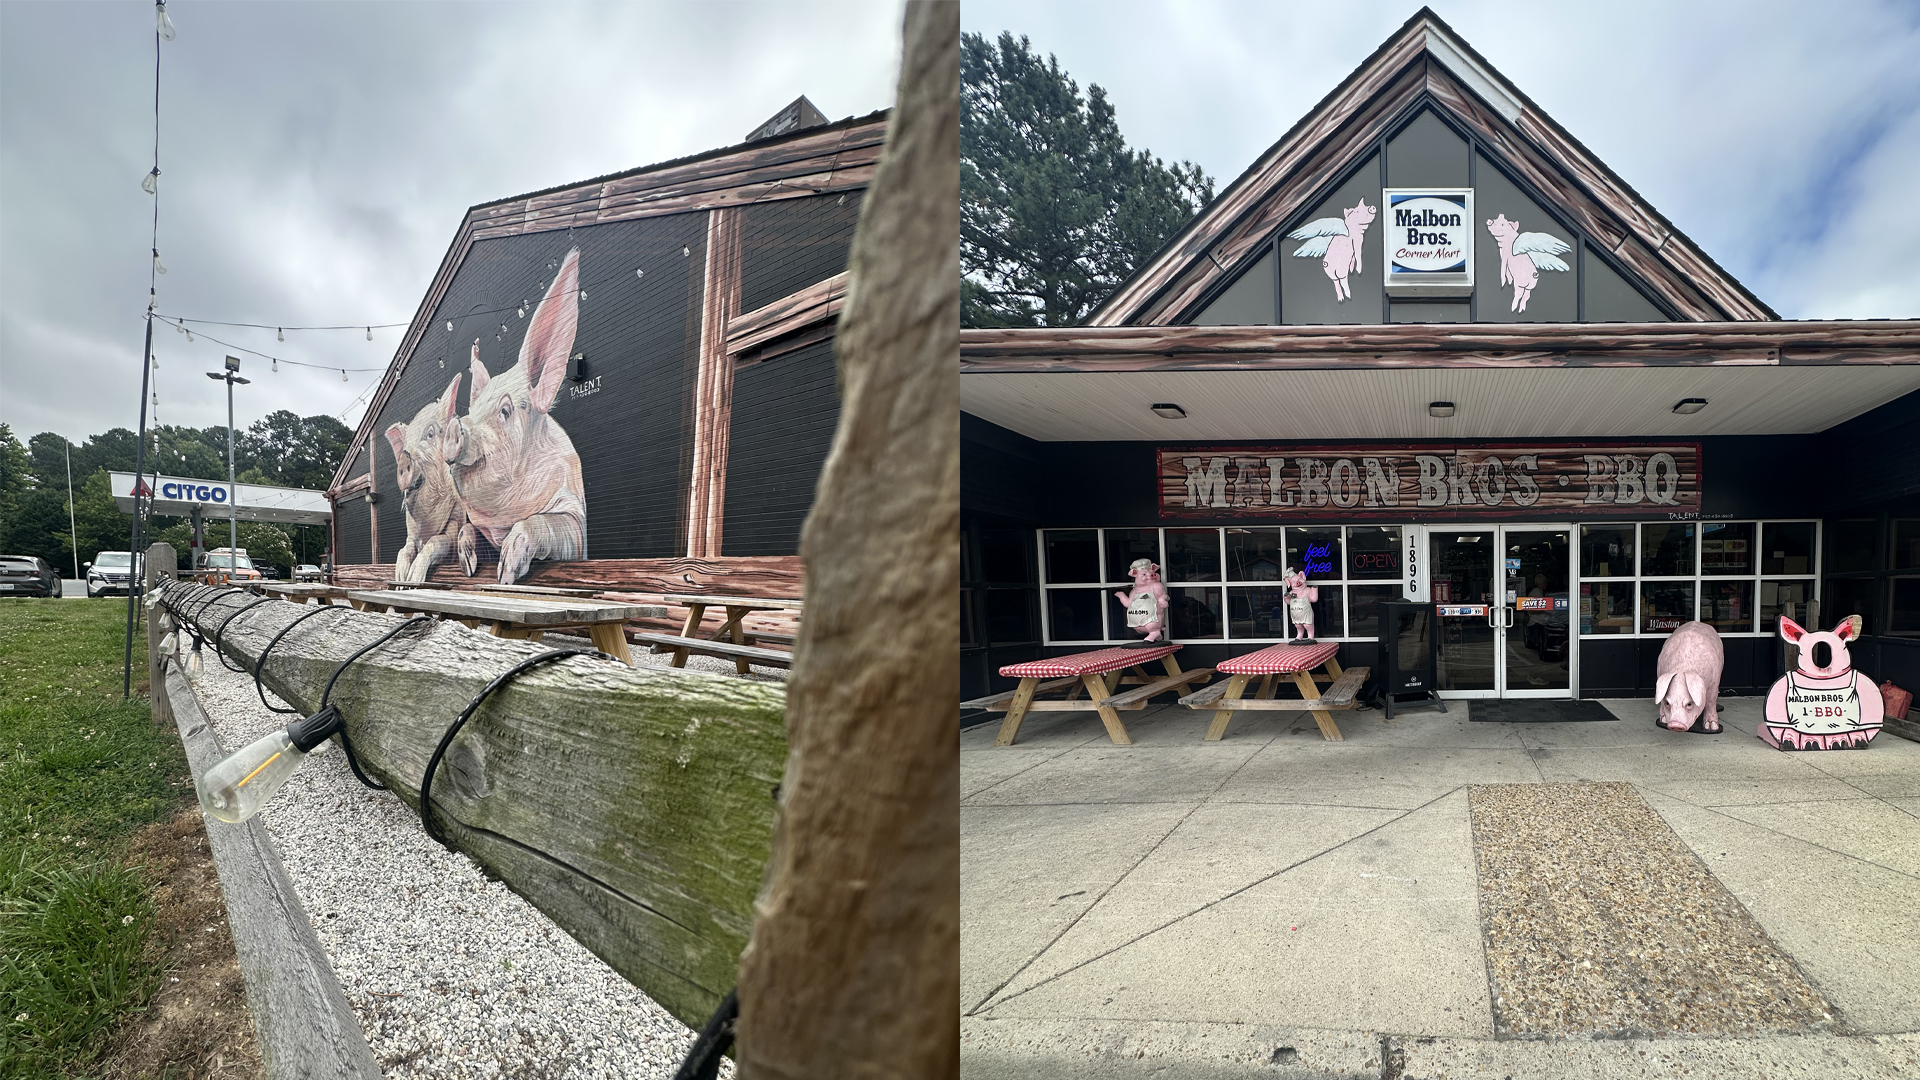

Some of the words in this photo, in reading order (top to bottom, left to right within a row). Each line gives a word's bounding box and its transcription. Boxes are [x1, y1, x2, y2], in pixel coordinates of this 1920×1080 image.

[1396, 209, 1461, 226] Malbon
[1407, 228, 1451, 245] Bros.
[1396, 248, 1432, 258] Corner
[1433, 248, 1460, 259] Mart
[1182, 456, 1400, 508] MALBON
[1415, 454, 1541, 506] BROS
[1583, 452, 1682, 506] BBQ
[162, 483, 227, 503] CITGO
[1304, 543, 1331, 562] feel
[1304, 559, 1332, 576] free
[1354, 554, 1397, 569] OPEN
[1409, 535, 1417, 592] 1896
[1649, 619, 1680, 629] Winston
[1821, 694, 1844, 702] BROS
